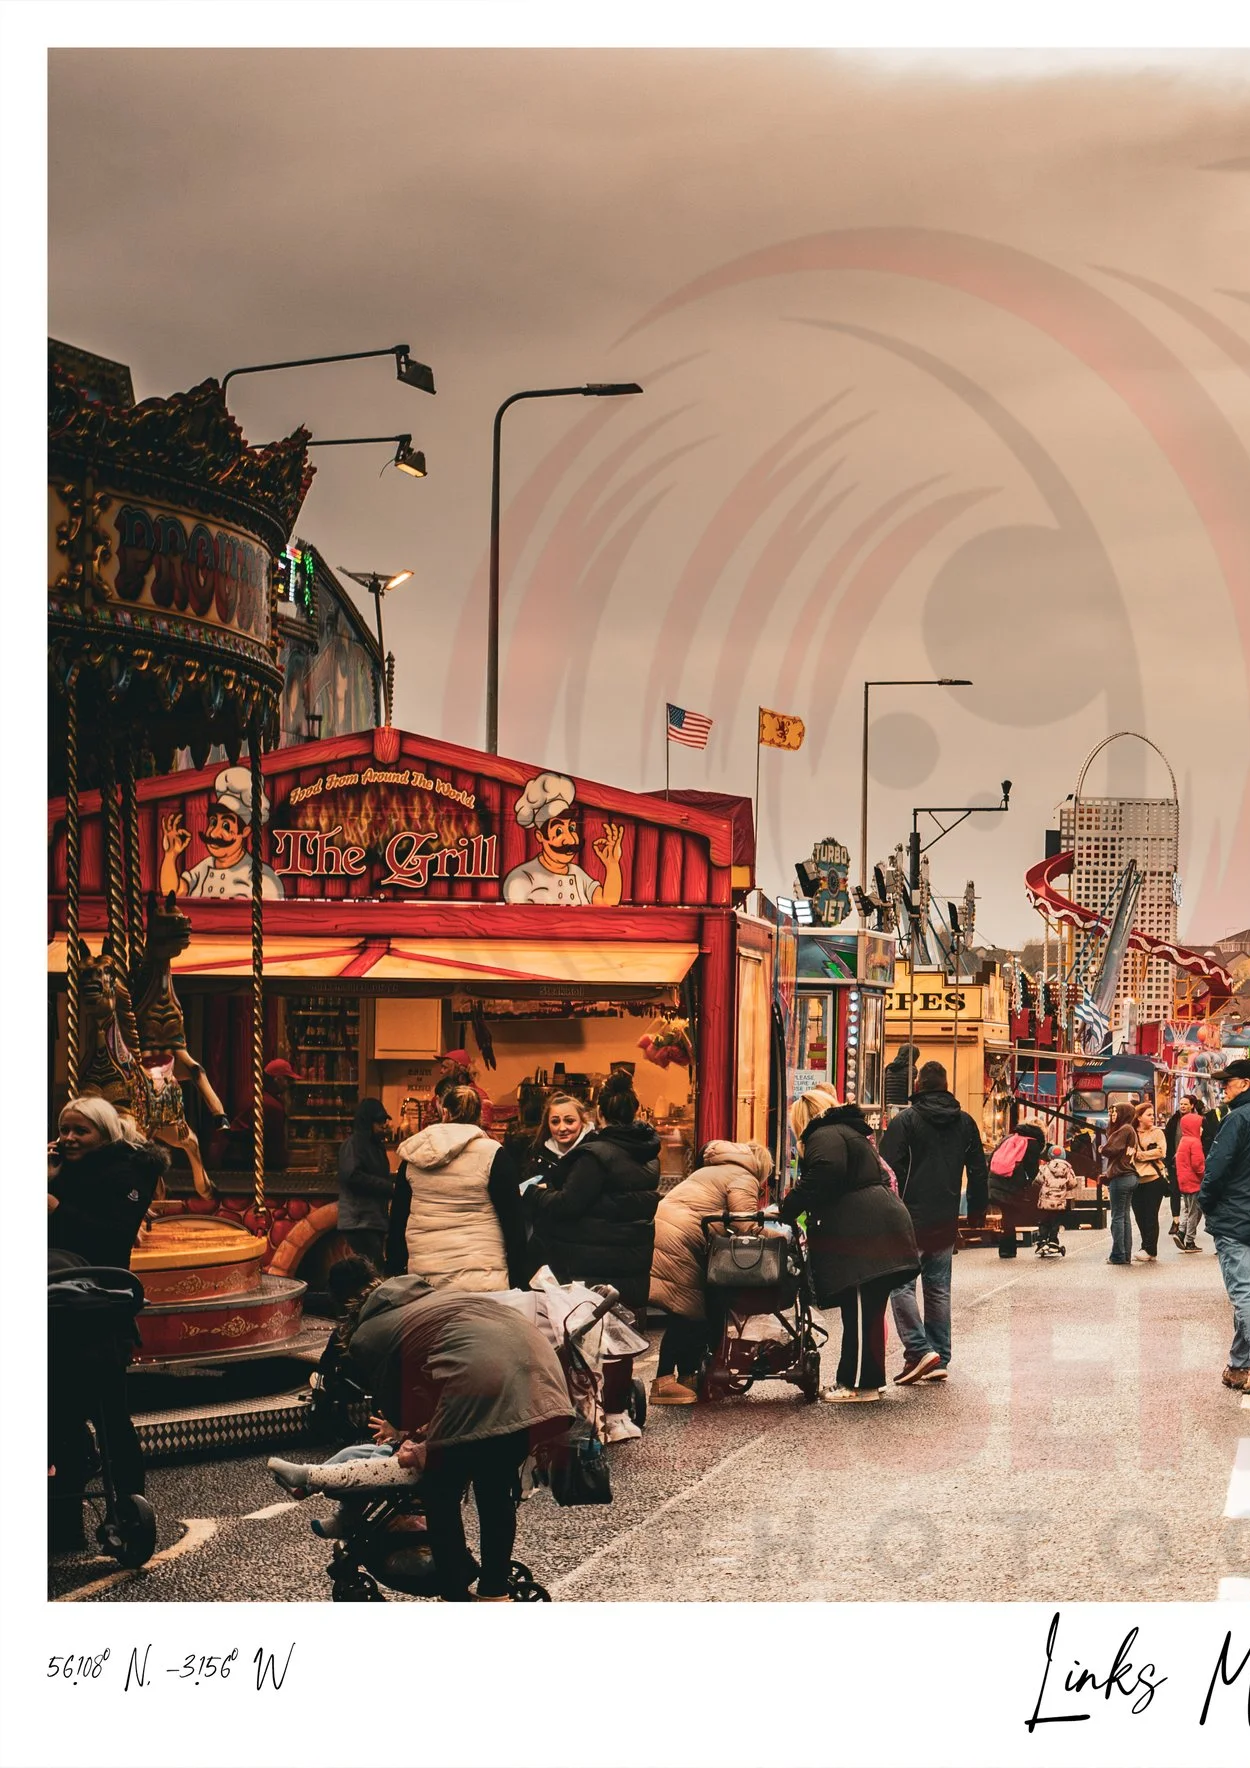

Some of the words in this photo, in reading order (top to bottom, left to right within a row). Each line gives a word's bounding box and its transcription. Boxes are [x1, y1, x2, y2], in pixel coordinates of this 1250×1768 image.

[289, 778, 322, 805] Food
[325, 773, 359, 791] From
[361, 768, 409, 785] Around
[411, 771, 434, 791] The
[435, 778, 475, 810] World
[272, 826, 367, 876] The
[380, 831, 500, 889] Grill
[814, 844, 848, 864] TURBO
[821, 900, 845, 923] JET
